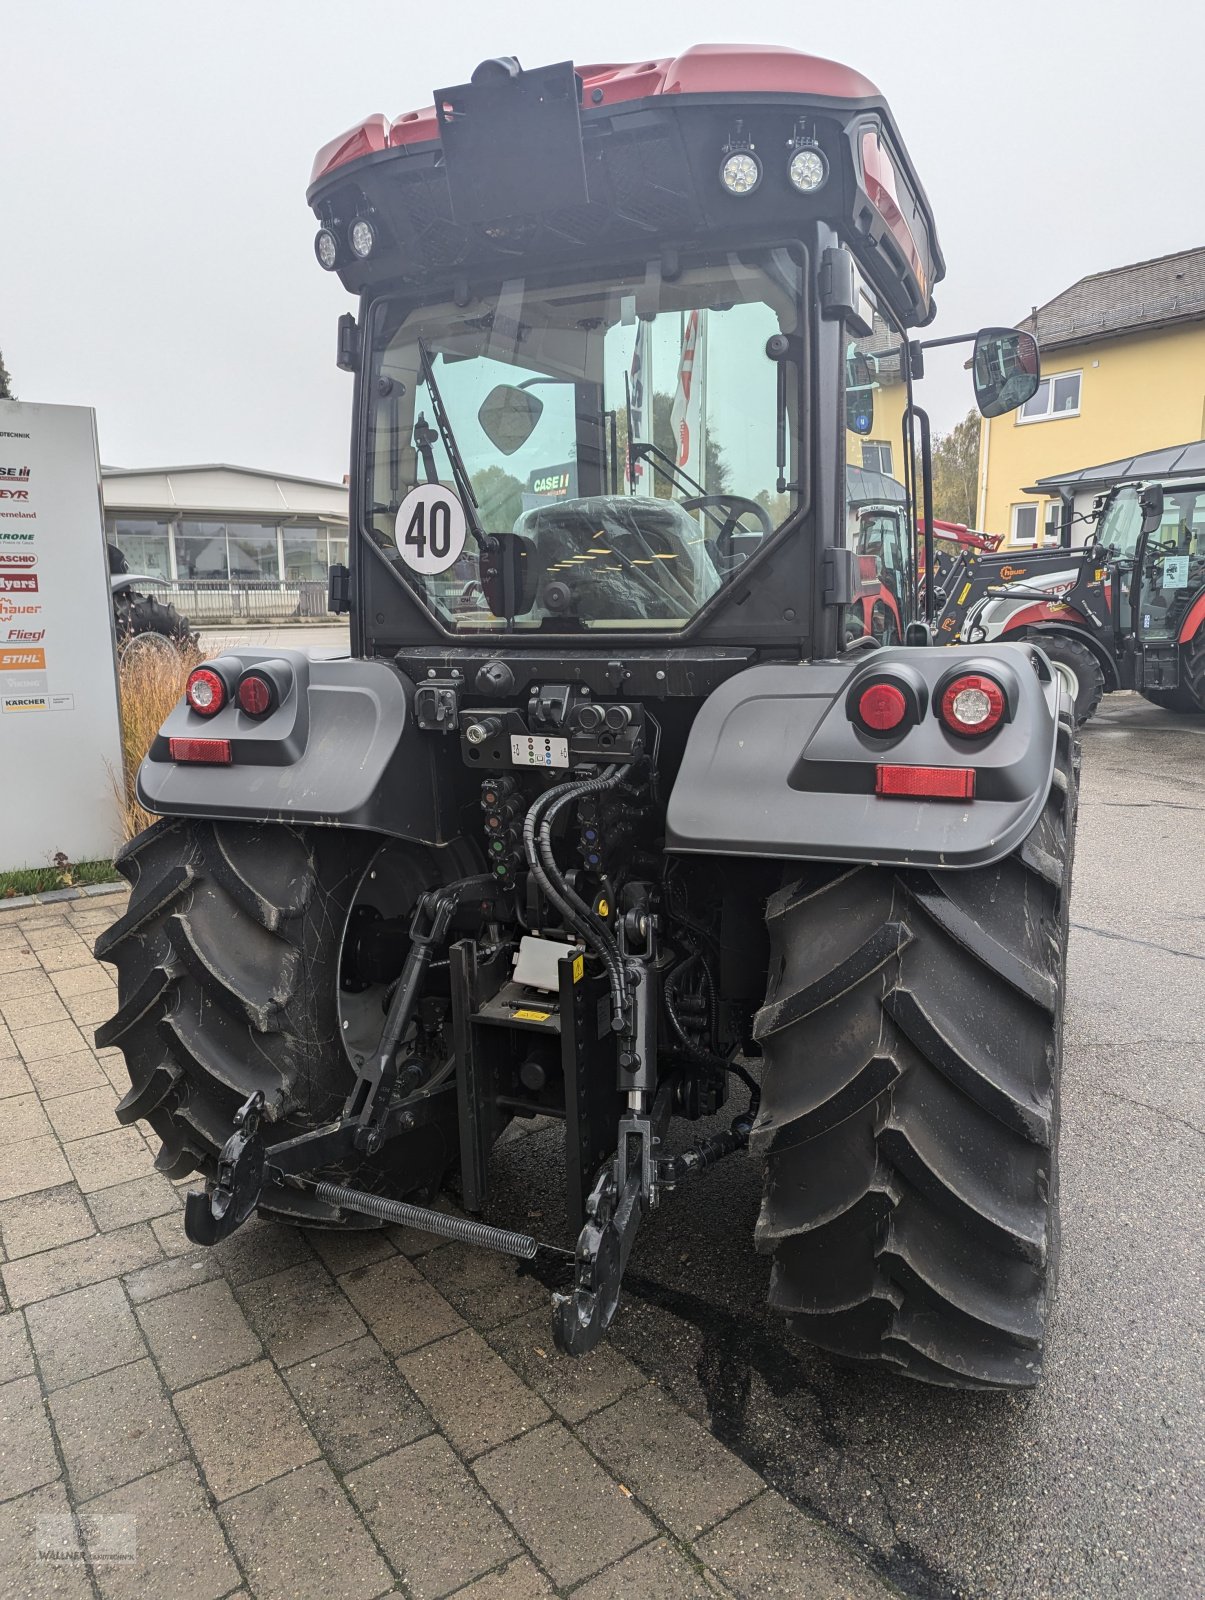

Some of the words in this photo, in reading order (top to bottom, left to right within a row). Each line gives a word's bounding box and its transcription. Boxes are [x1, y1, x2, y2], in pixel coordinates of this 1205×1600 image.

[533, 475, 560, 493] CASE
[405, 501, 450, 558] 40
[8, 629, 45, 642] Fliegl
[2, 655, 40, 664] STIHL
